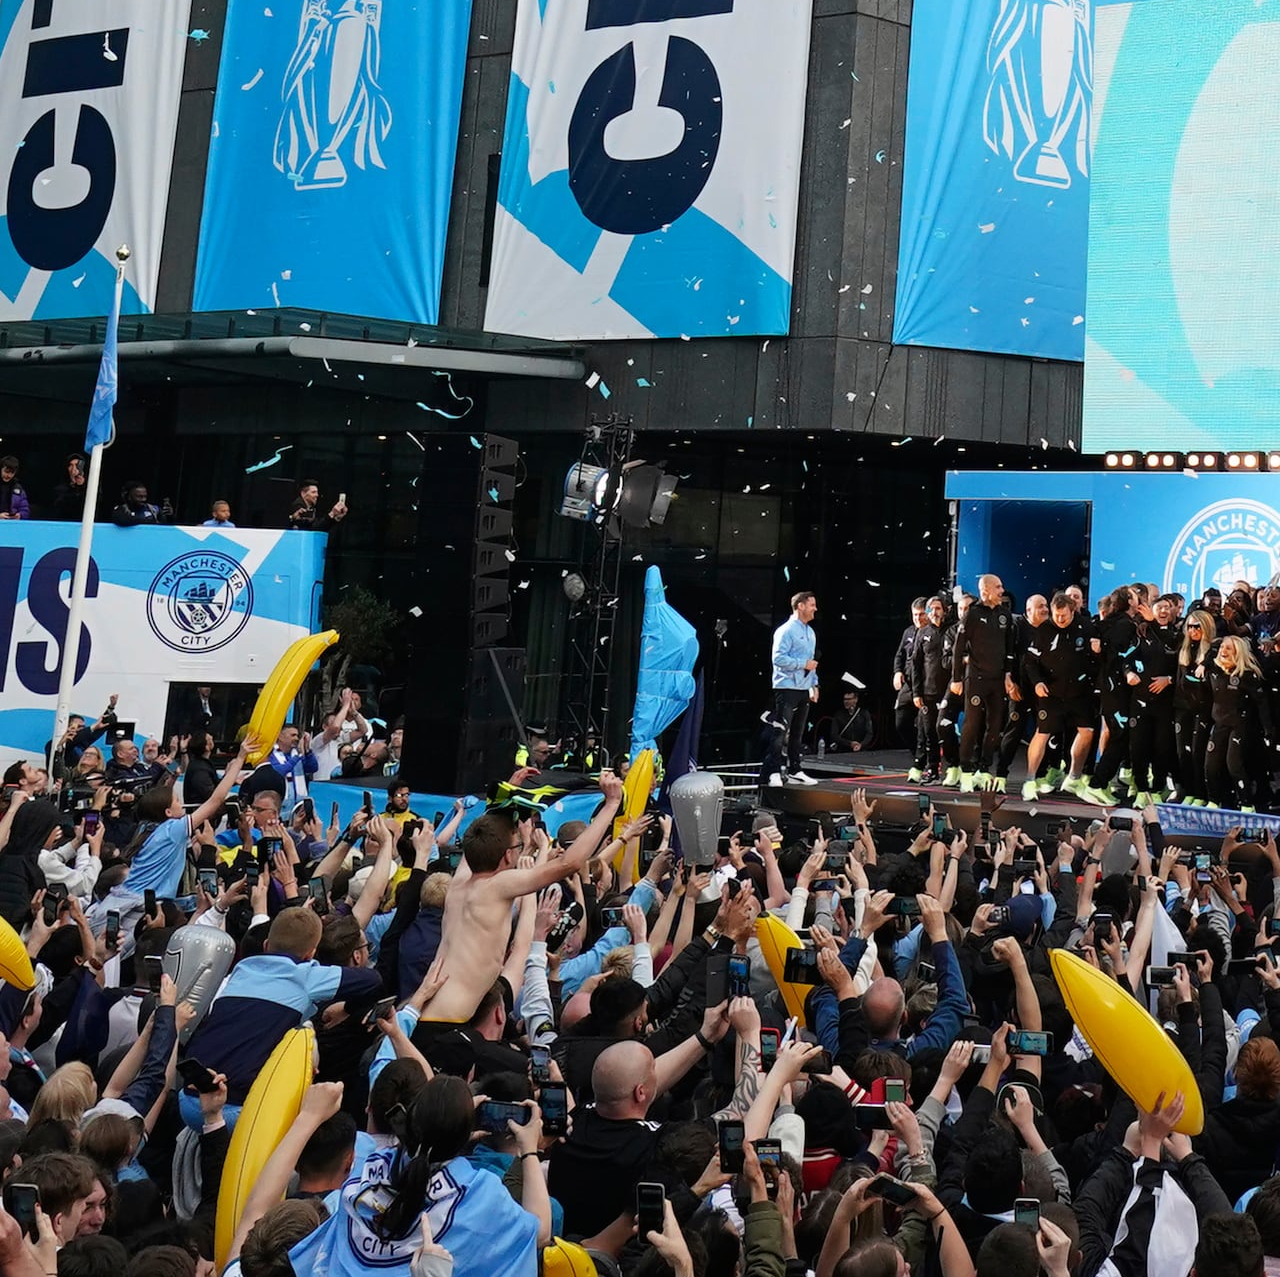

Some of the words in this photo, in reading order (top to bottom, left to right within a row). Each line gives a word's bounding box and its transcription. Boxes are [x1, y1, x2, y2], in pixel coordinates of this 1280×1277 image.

[161, 557, 244, 591] MANCHESTER
[180, 635, 212, 645] CITY
[362, 1236, 402, 1256] CITY
